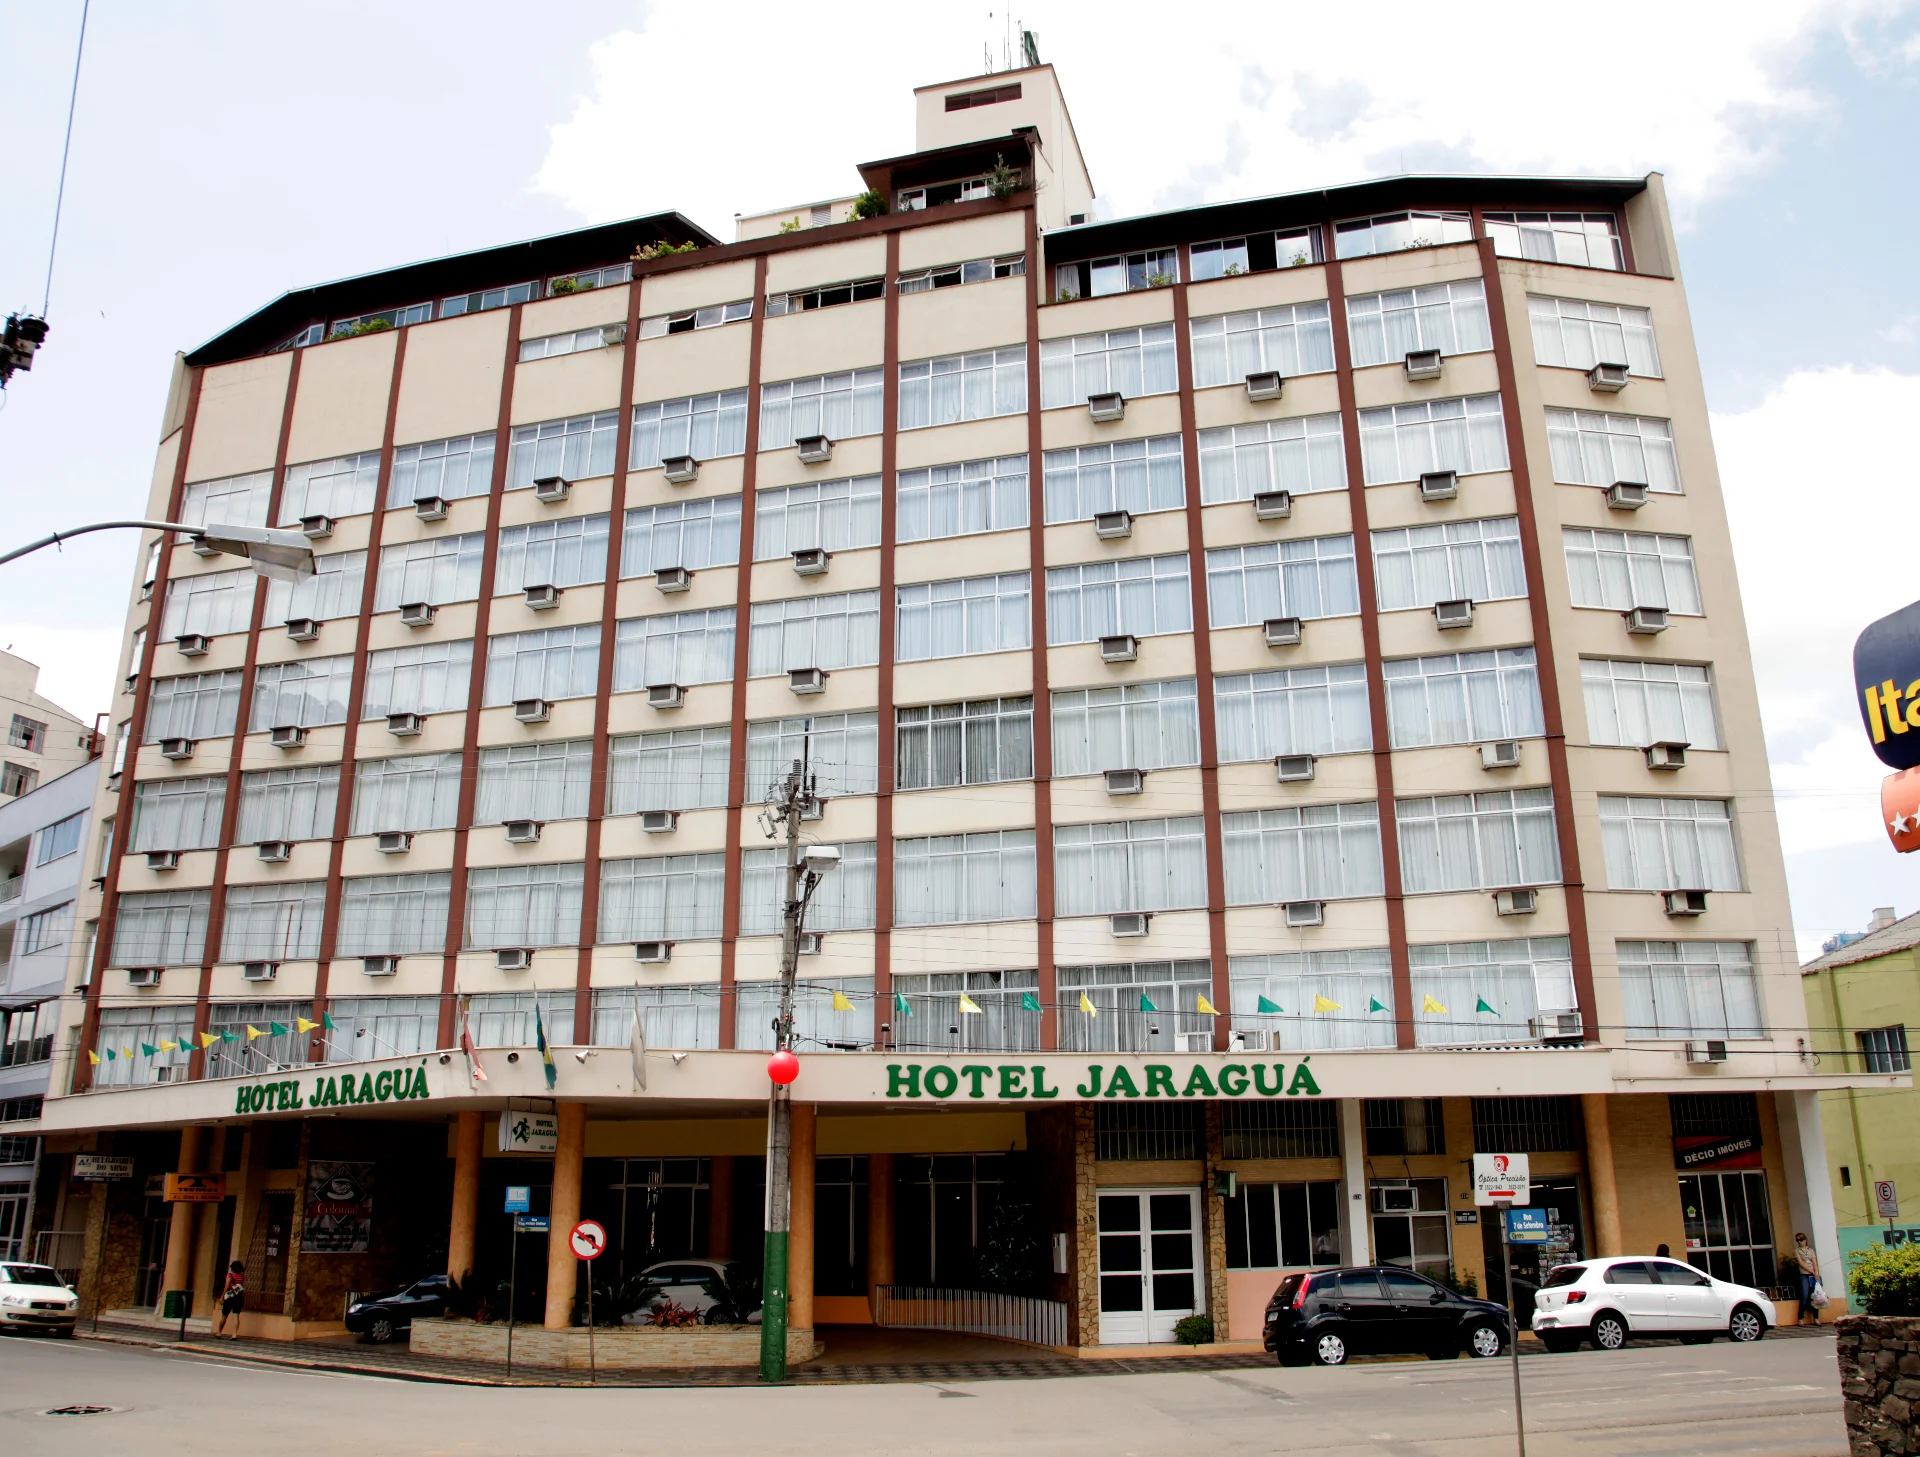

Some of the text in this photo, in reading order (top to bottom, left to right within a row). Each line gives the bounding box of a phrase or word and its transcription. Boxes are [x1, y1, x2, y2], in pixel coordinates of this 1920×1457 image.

[886, 1056, 1321, 1098] HOTEL JARAGUÁ
[235, 1058, 429, 1113] HOTEL JARAGUÁ
[536, 1119, 553, 1127] HOTEL
[1684, 1139, 1752, 1164] DÉCIO IMÓVEIS
[1500, 1173, 1526, 1182] Precisão
[1883, 1186, 1889, 1196] E
[318, 1203, 359, 1214] Colonial
